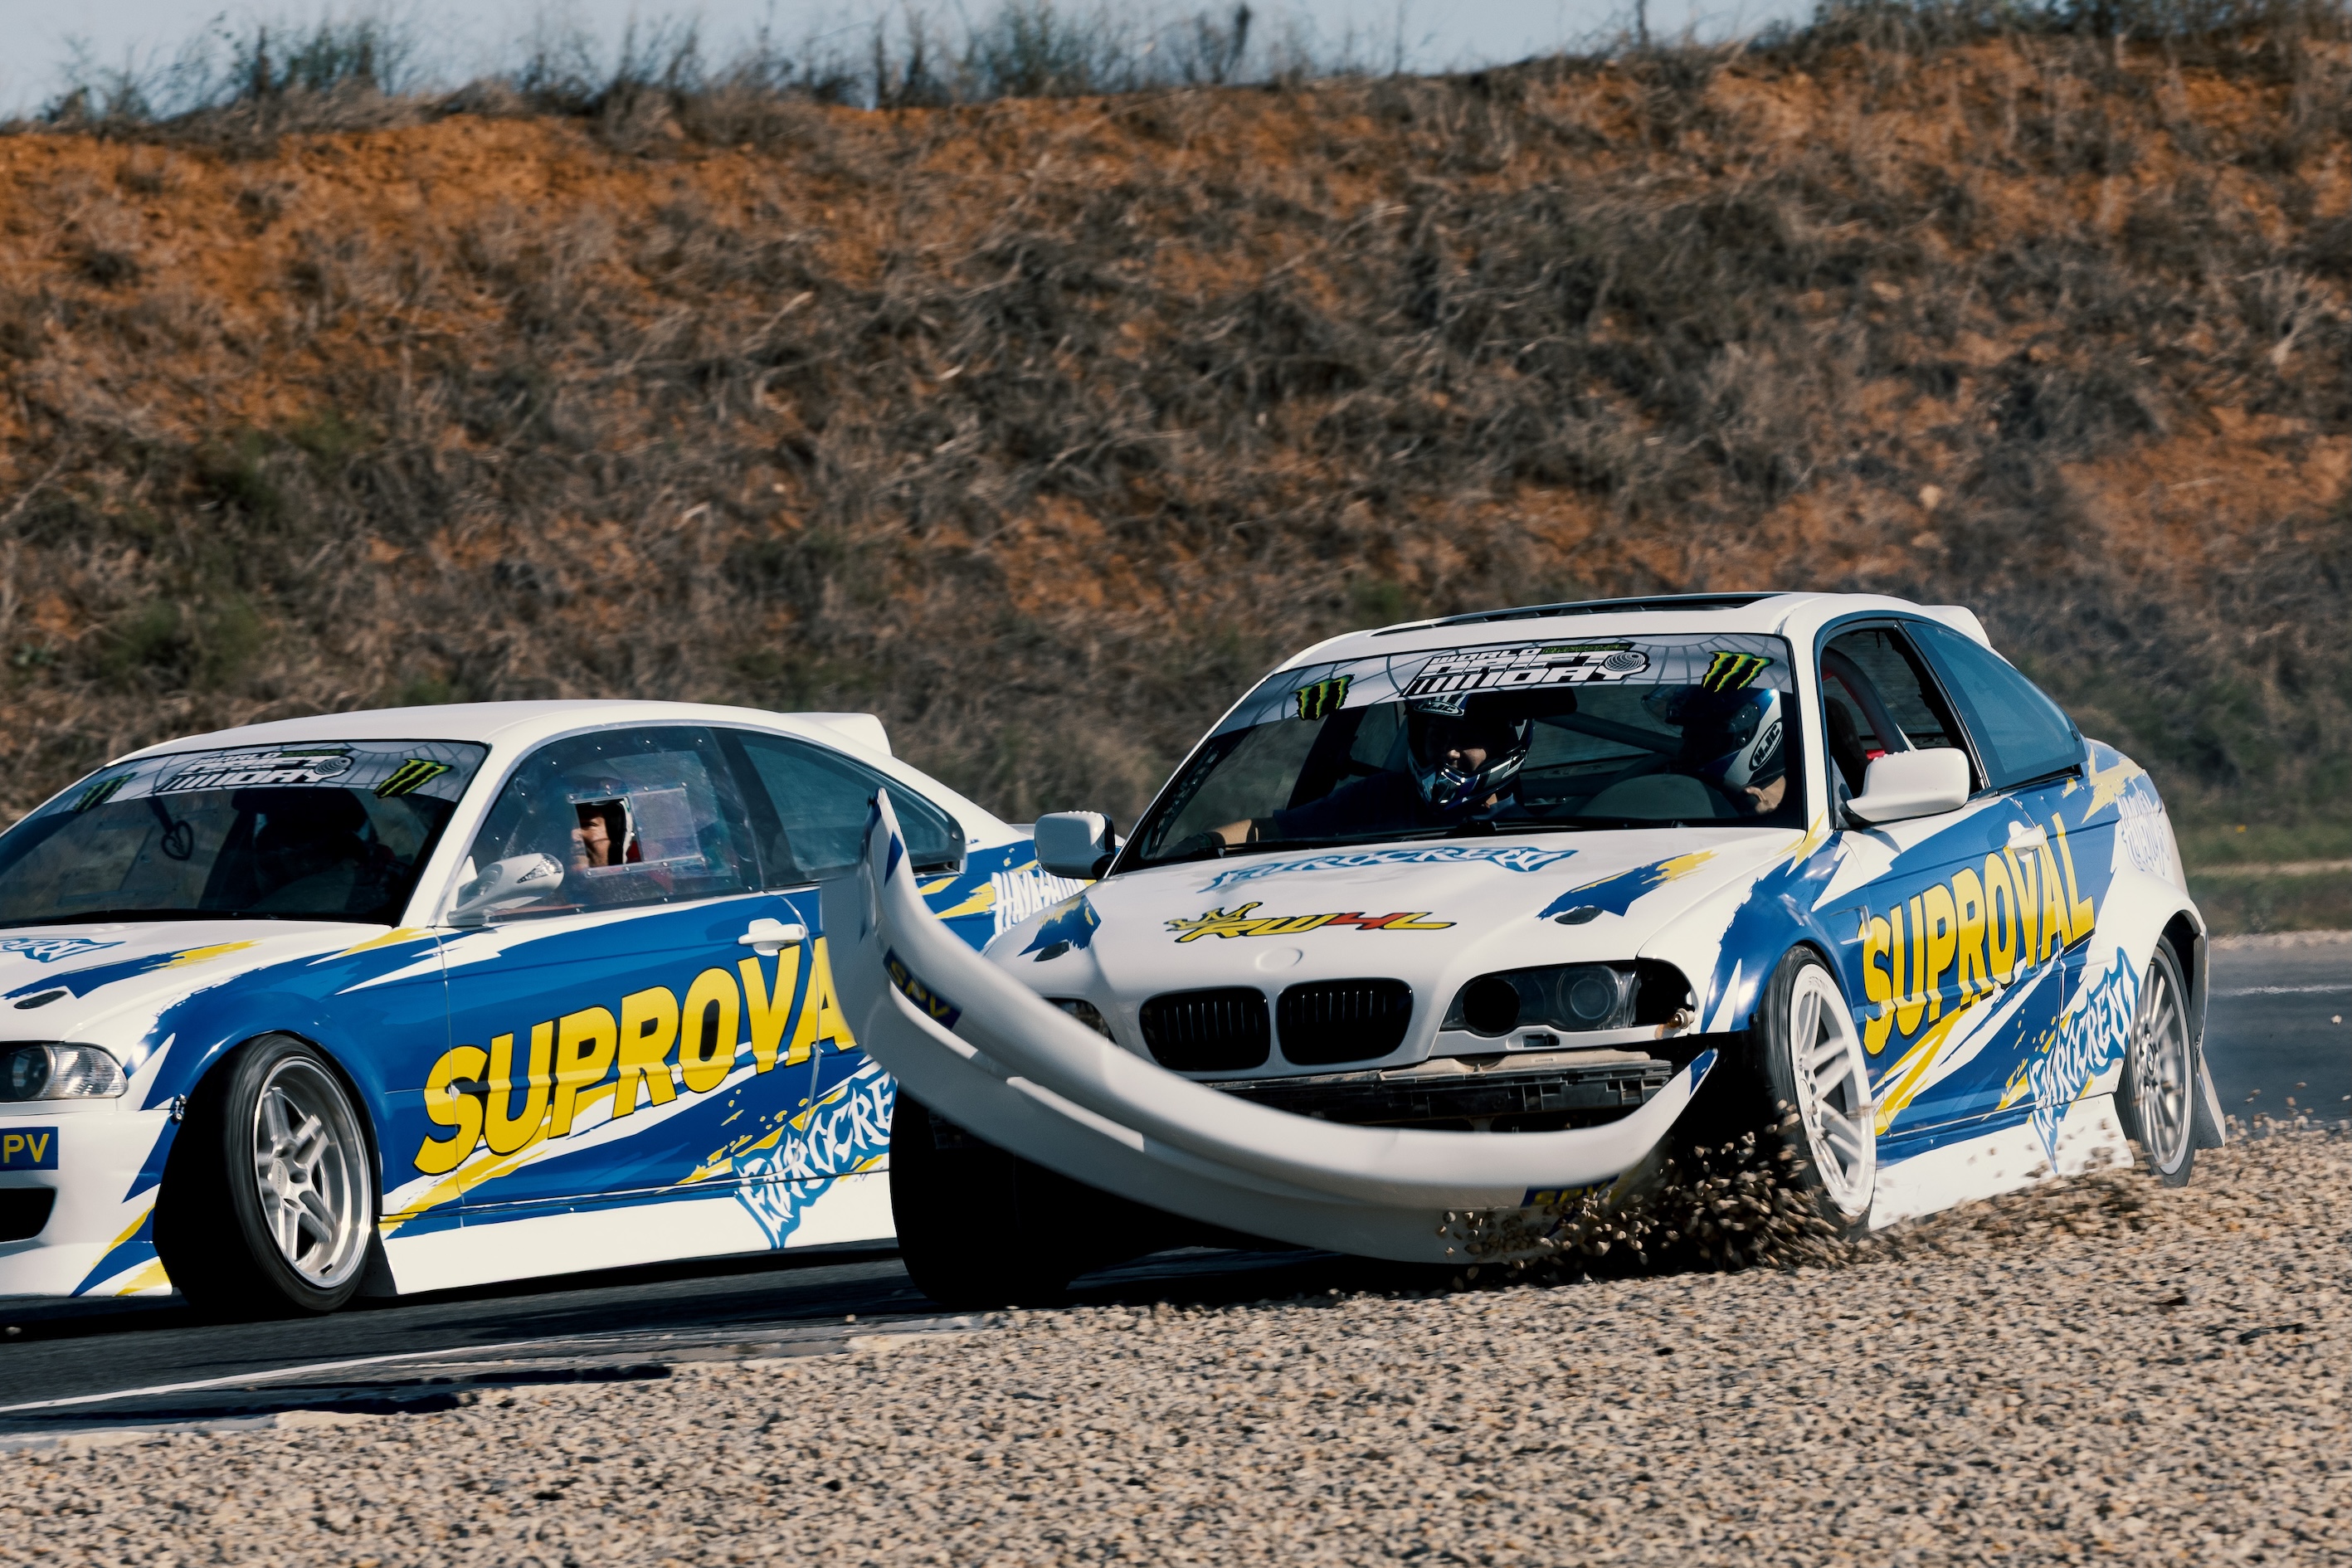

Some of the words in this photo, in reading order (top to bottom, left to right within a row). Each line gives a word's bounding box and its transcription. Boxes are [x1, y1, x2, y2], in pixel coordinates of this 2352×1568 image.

[1415, 650, 1626, 679] DRIFT
[1431, 647, 1543, 664] WORLD
[197, 752, 284, 764] WORLD
[1753, 723, 1780, 766] HJC
[178, 755, 342, 776] DRIFT
[1857, 811, 2096, 1057] SUPROVAL
[412, 936, 859, 1177] SUPROVA
[2, 1132, 51, 1164] PV
[735, 1070, 898, 1248] EUROCRE
